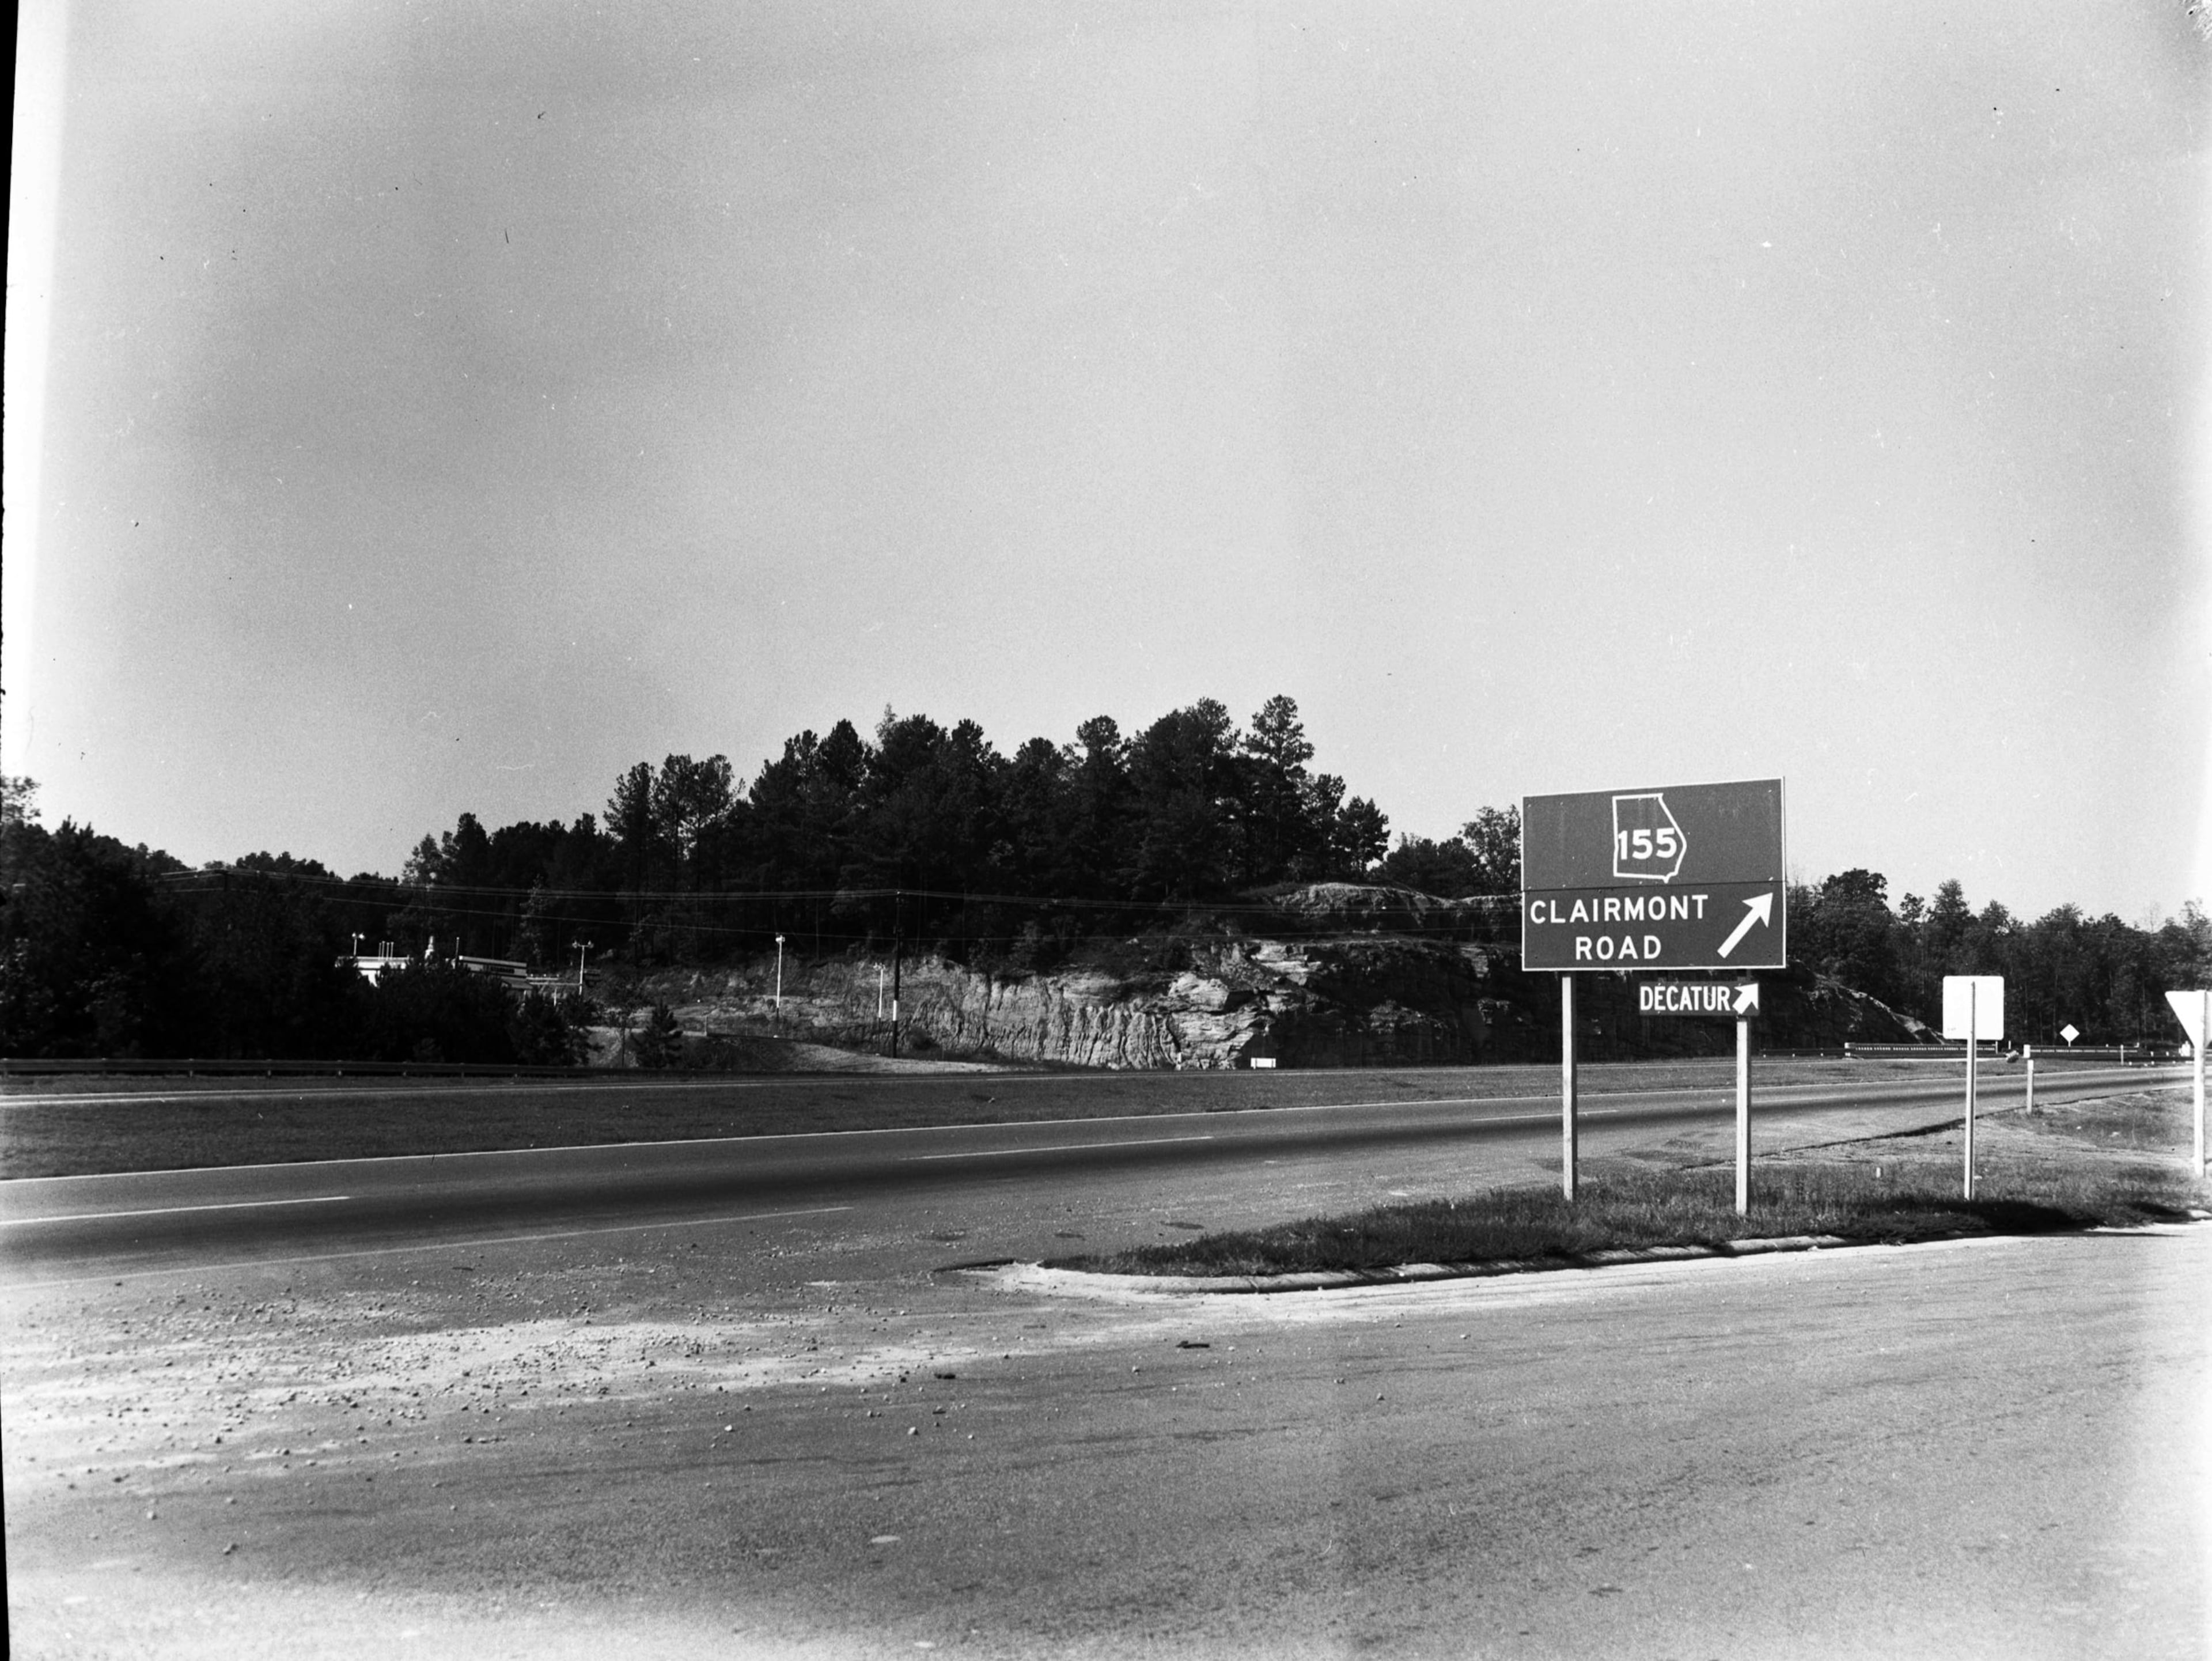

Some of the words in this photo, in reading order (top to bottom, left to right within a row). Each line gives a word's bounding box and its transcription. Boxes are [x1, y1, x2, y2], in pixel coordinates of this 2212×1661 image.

[1618, 827, 1677, 860] 155
[1530, 894, 1709, 924] CLAIRMONT
[1575, 935, 1661, 960] ROAD
[1640, 985, 1731, 1012] DECATUR
